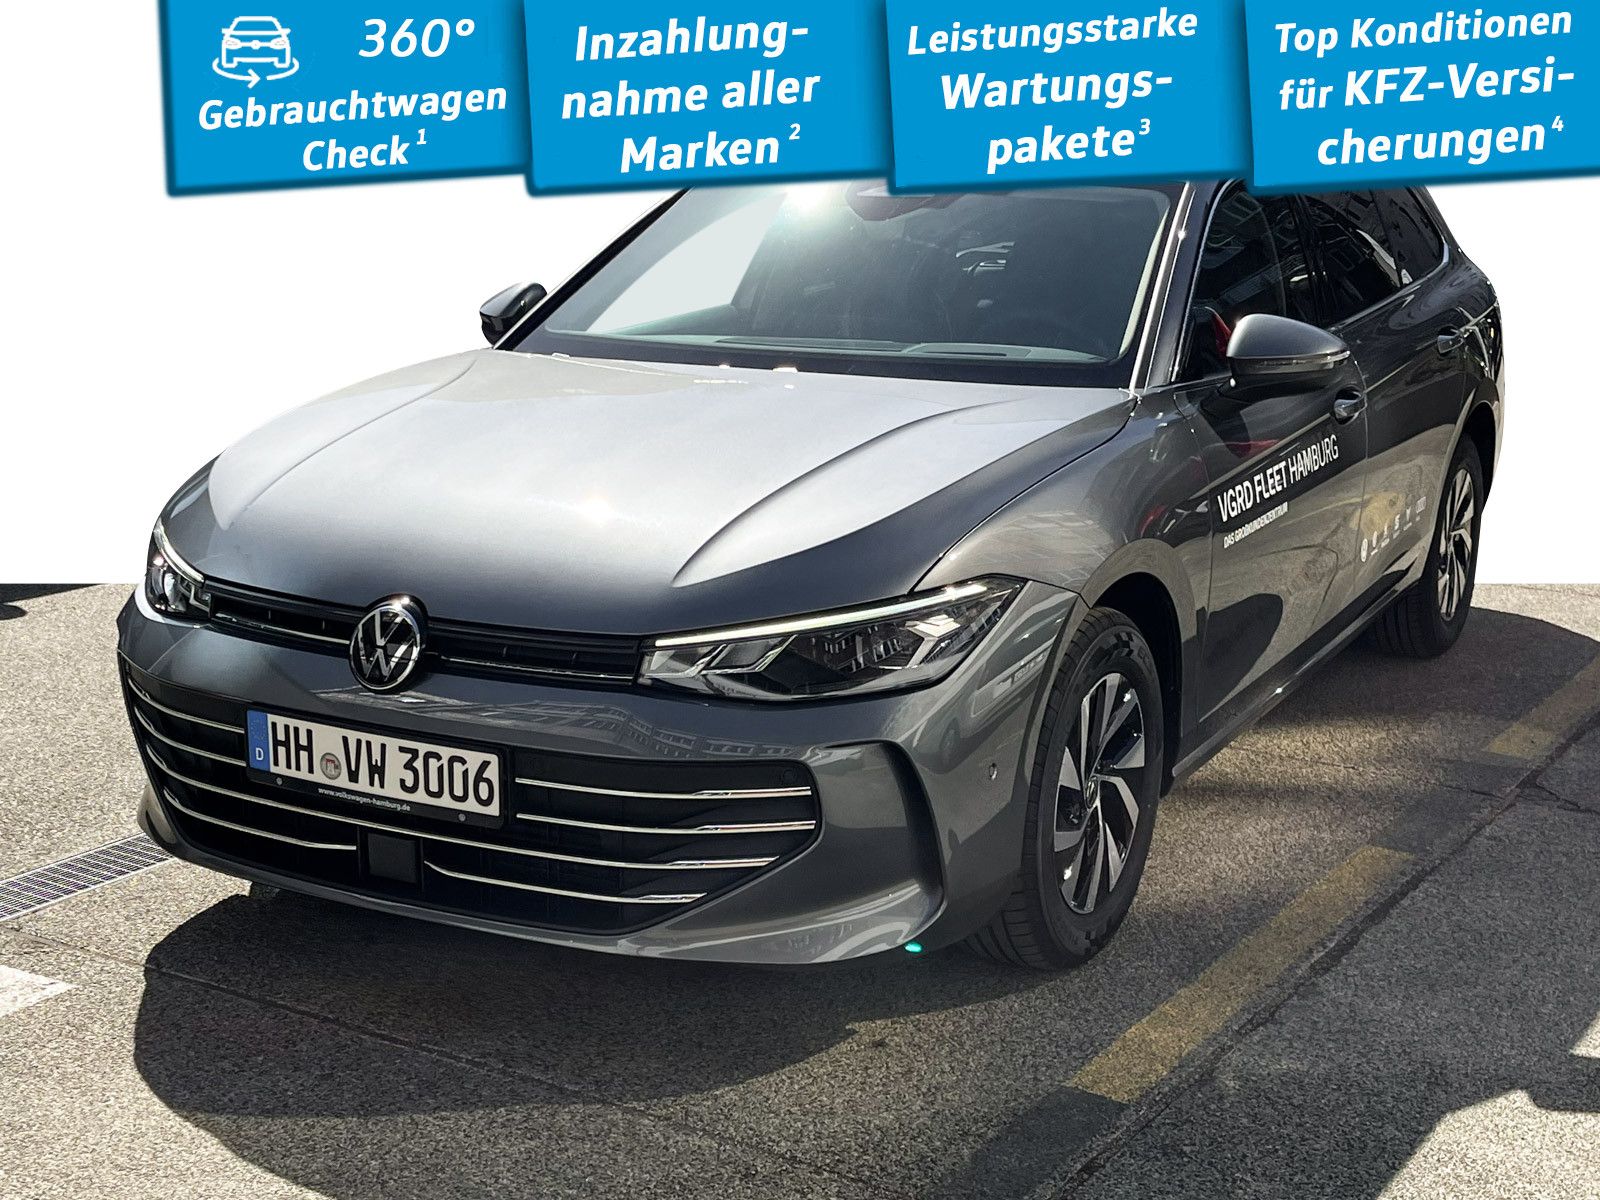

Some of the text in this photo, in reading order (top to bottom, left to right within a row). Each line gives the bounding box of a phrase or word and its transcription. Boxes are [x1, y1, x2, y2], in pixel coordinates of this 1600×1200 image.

[1217, 434, 1339, 523] VGRD FLEET HAMBURG
[255, 747, 264, 761] D
[271, 721, 495, 807] HH VW 3006
